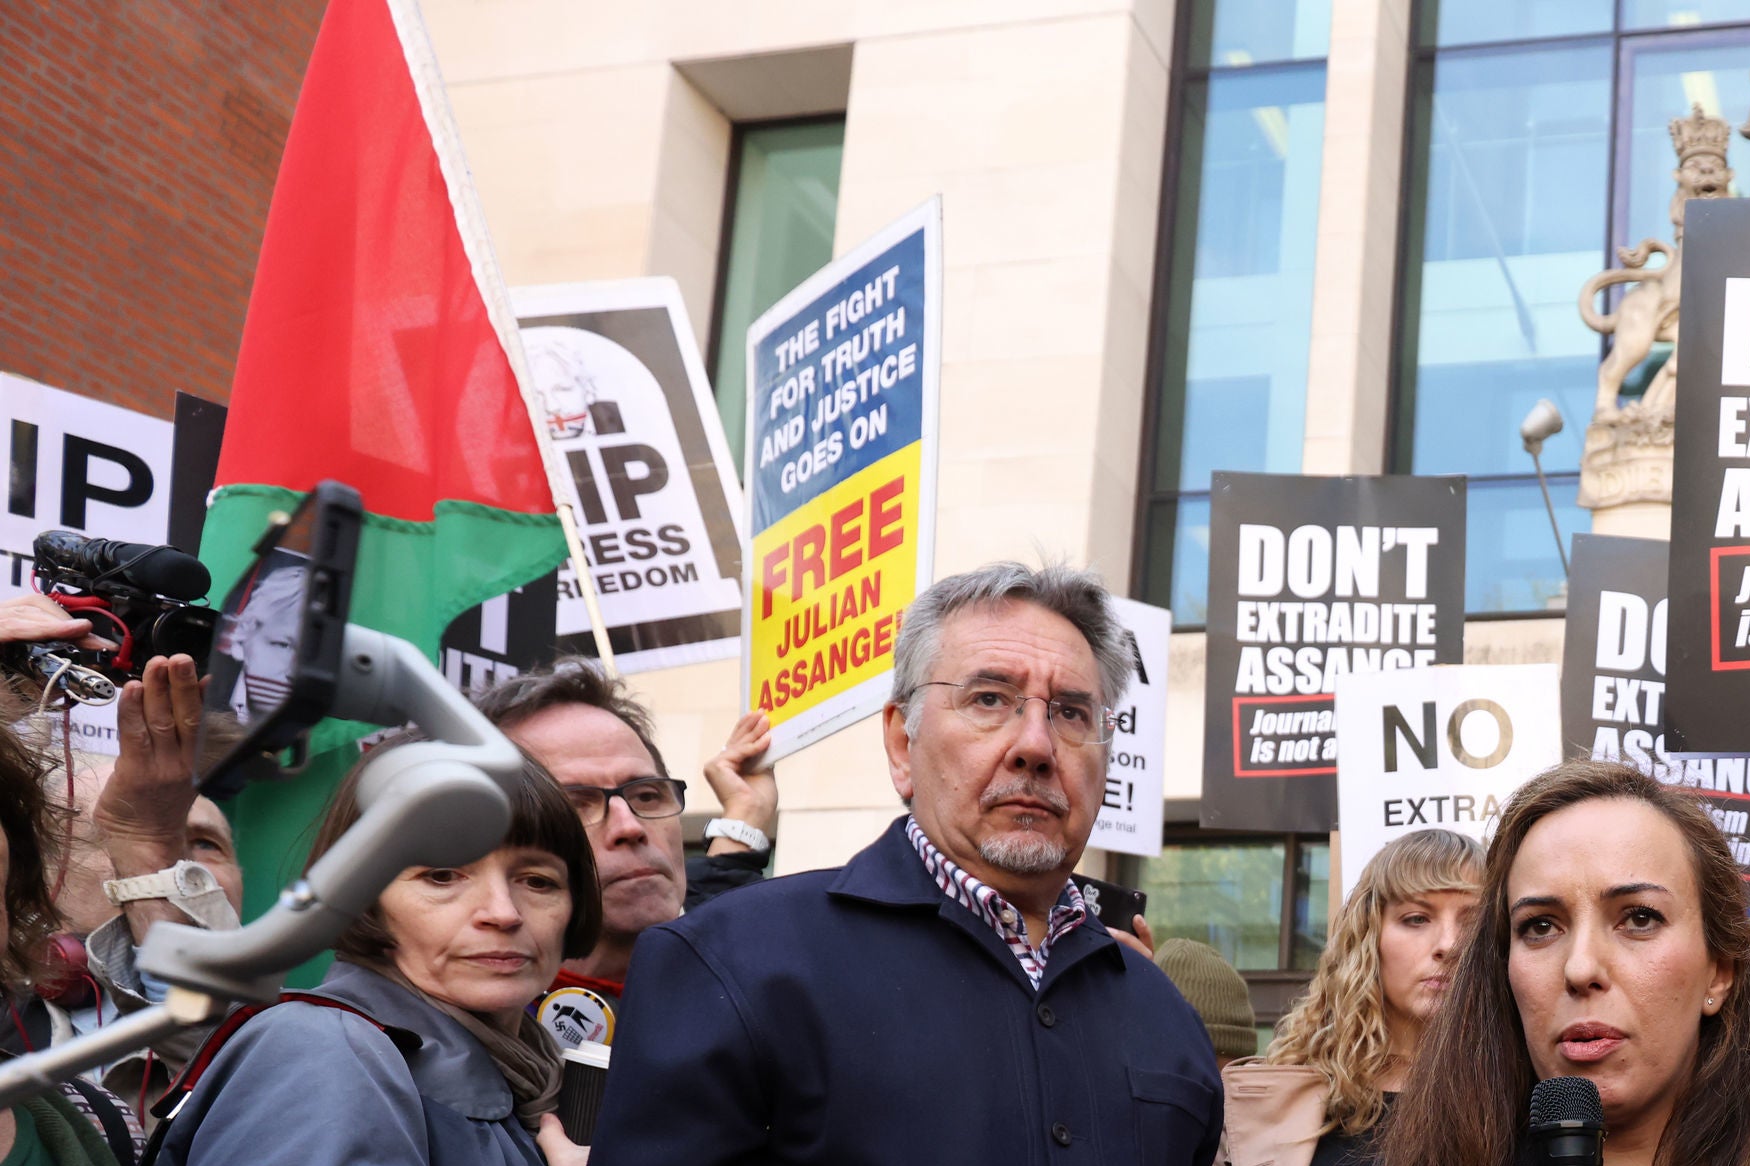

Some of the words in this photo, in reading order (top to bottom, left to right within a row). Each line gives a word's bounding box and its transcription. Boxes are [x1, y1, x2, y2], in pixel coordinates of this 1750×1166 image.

[776, 319, 819, 373] THE
[825, 265, 900, 340] FIGHT
[760, 414, 805, 469] AND
[812, 343, 917, 433] JUSTICE
[770, 366, 816, 420] FOR
[821, 306, 905, 384] TRUTH
[565, 443, 669, 526] IP
[780, 431, 843, 494] GOES
[850, 404, 888, 450] ON
[556, 563, 698, 601] REDOM
[762, 474, 905, 621] FREE
[1238, 524, 1438, 598] DON'T
[776, 569, 881, 658] JULIAN
[1236, 601, 1437, 645] EXTRADITE
[1250, 737, 1275, 763] is
[1278, 736, 1320, 762] not
[1382, 698, 1513, 773] NO
